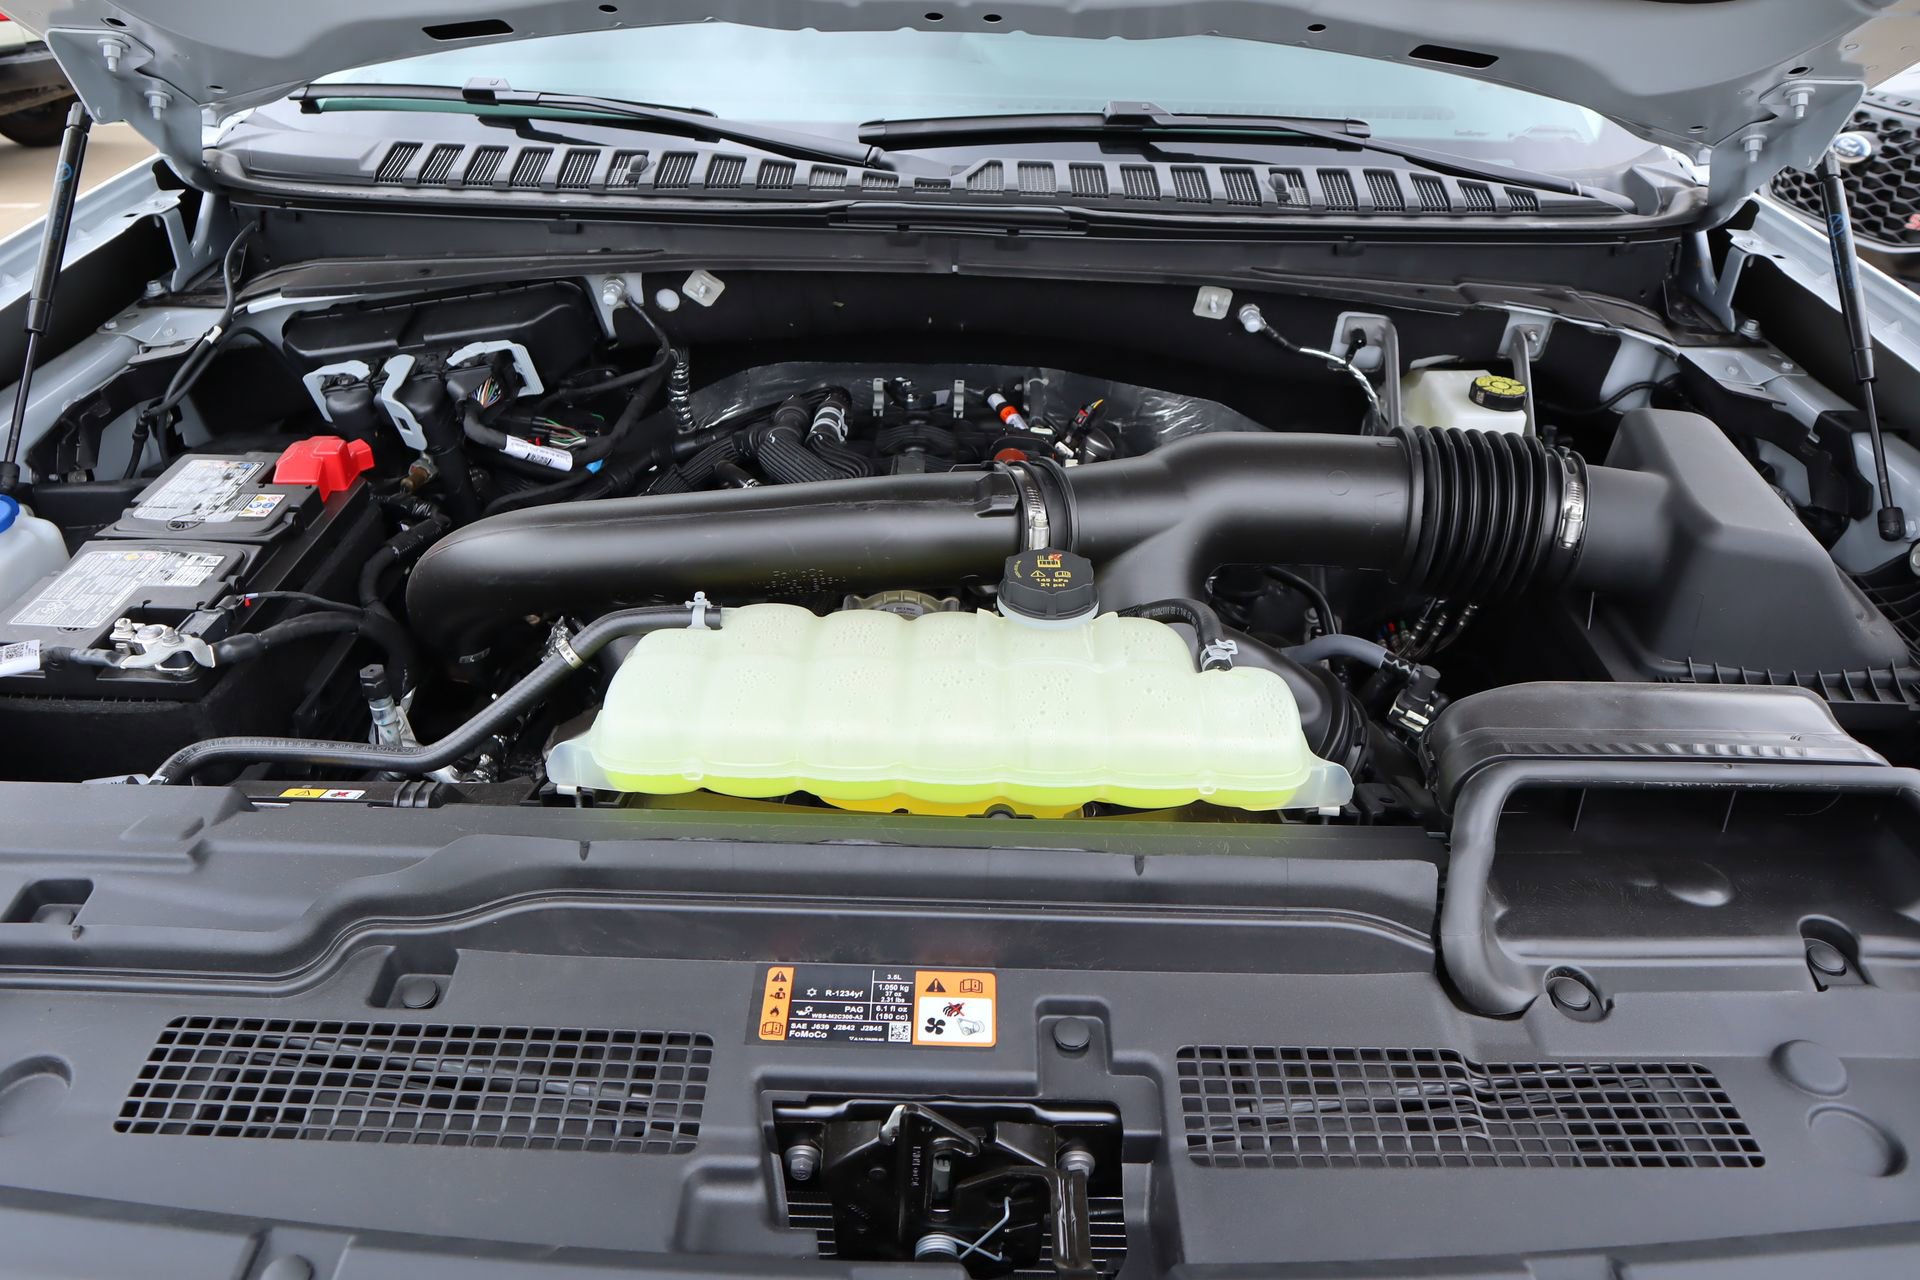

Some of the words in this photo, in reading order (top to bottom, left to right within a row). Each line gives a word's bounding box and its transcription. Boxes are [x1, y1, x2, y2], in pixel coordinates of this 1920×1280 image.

[899, 984, 910, 993] kg
[825, 989, 864, 999] R-1234yf
[875, 1012, 893, 1020] (180
[895, 1013, 908, 1021] cc)
[790, 1022, 808, 1030] SAE
[789, 1030, 827, 1038] FoMoCo
